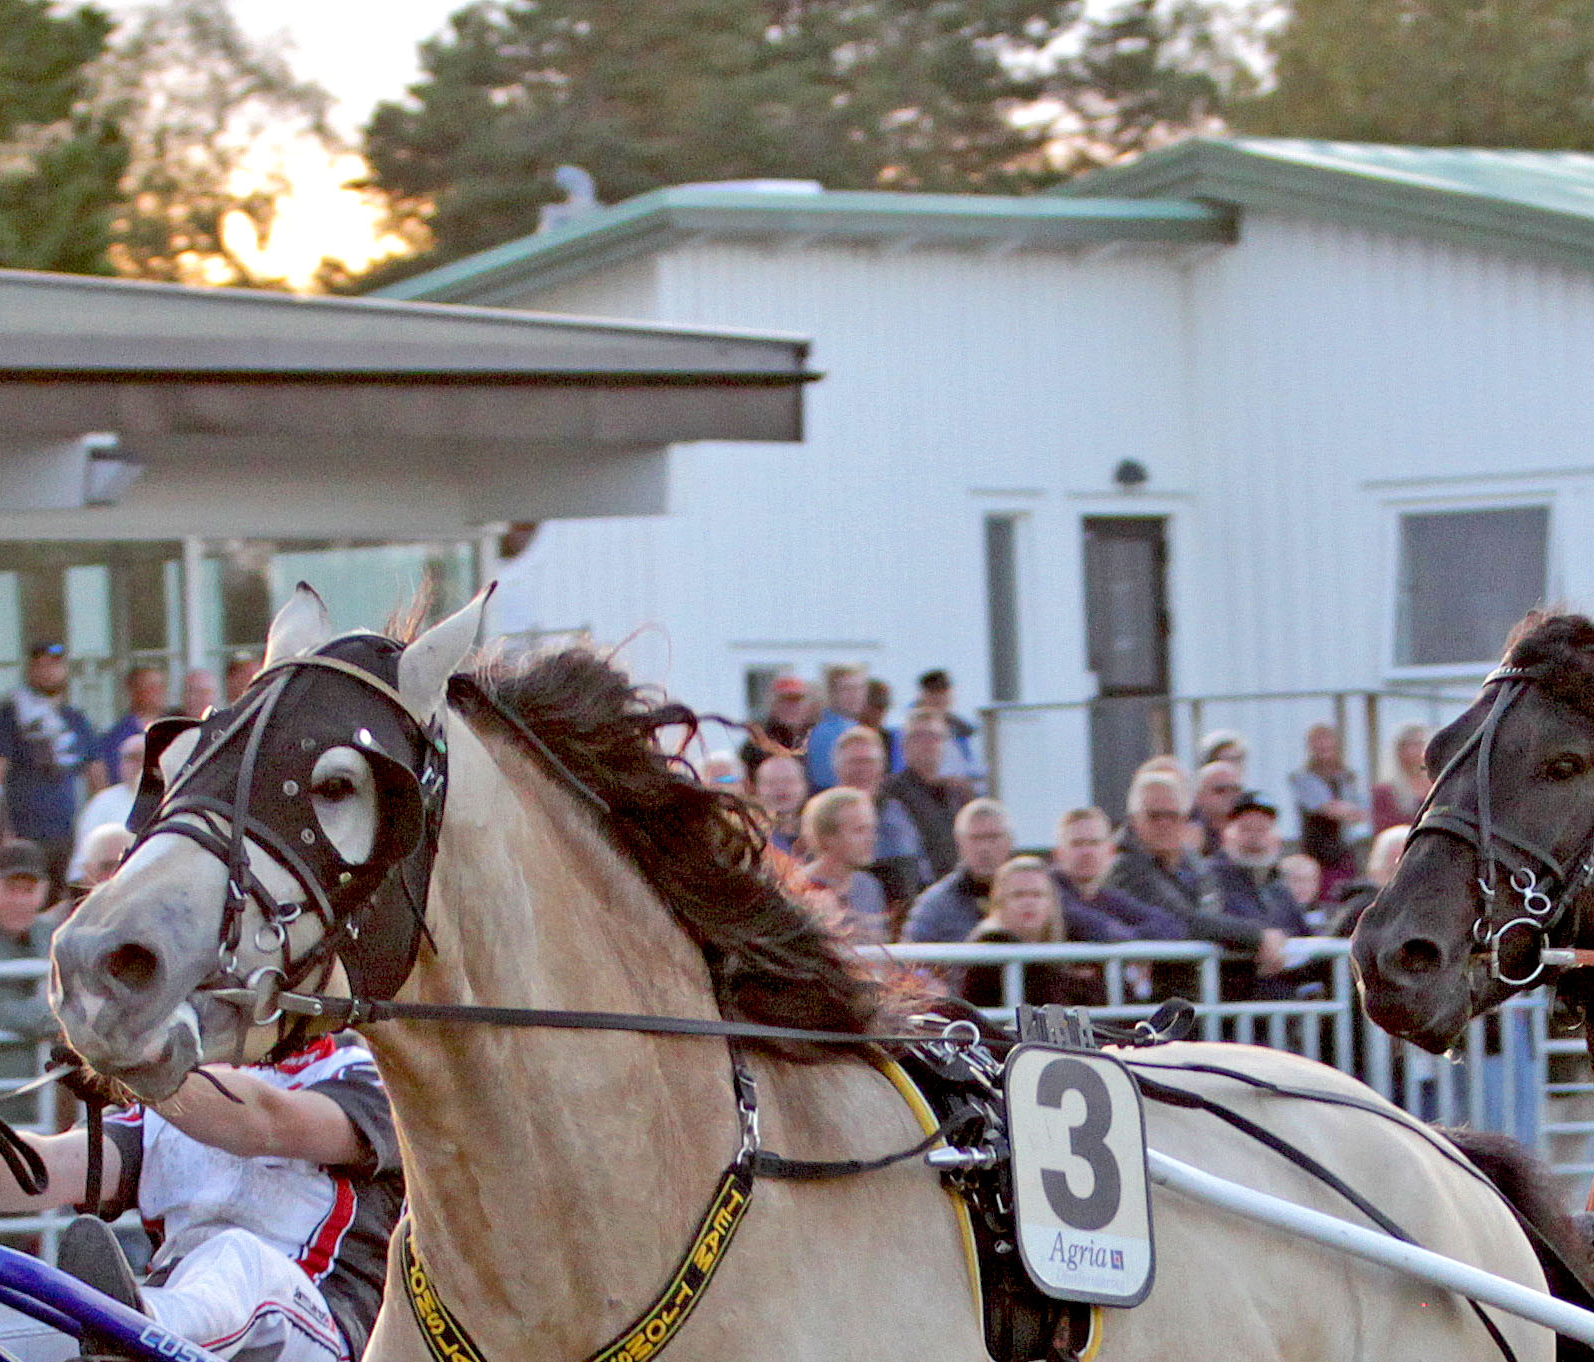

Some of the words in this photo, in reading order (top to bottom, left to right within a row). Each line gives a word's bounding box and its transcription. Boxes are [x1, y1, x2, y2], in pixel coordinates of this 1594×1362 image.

[1036, 1058, 1122, 1231] 3
[694, 1188, 744, 1273] TEAM
[1048, 1231, 1108, 1271] Agria
